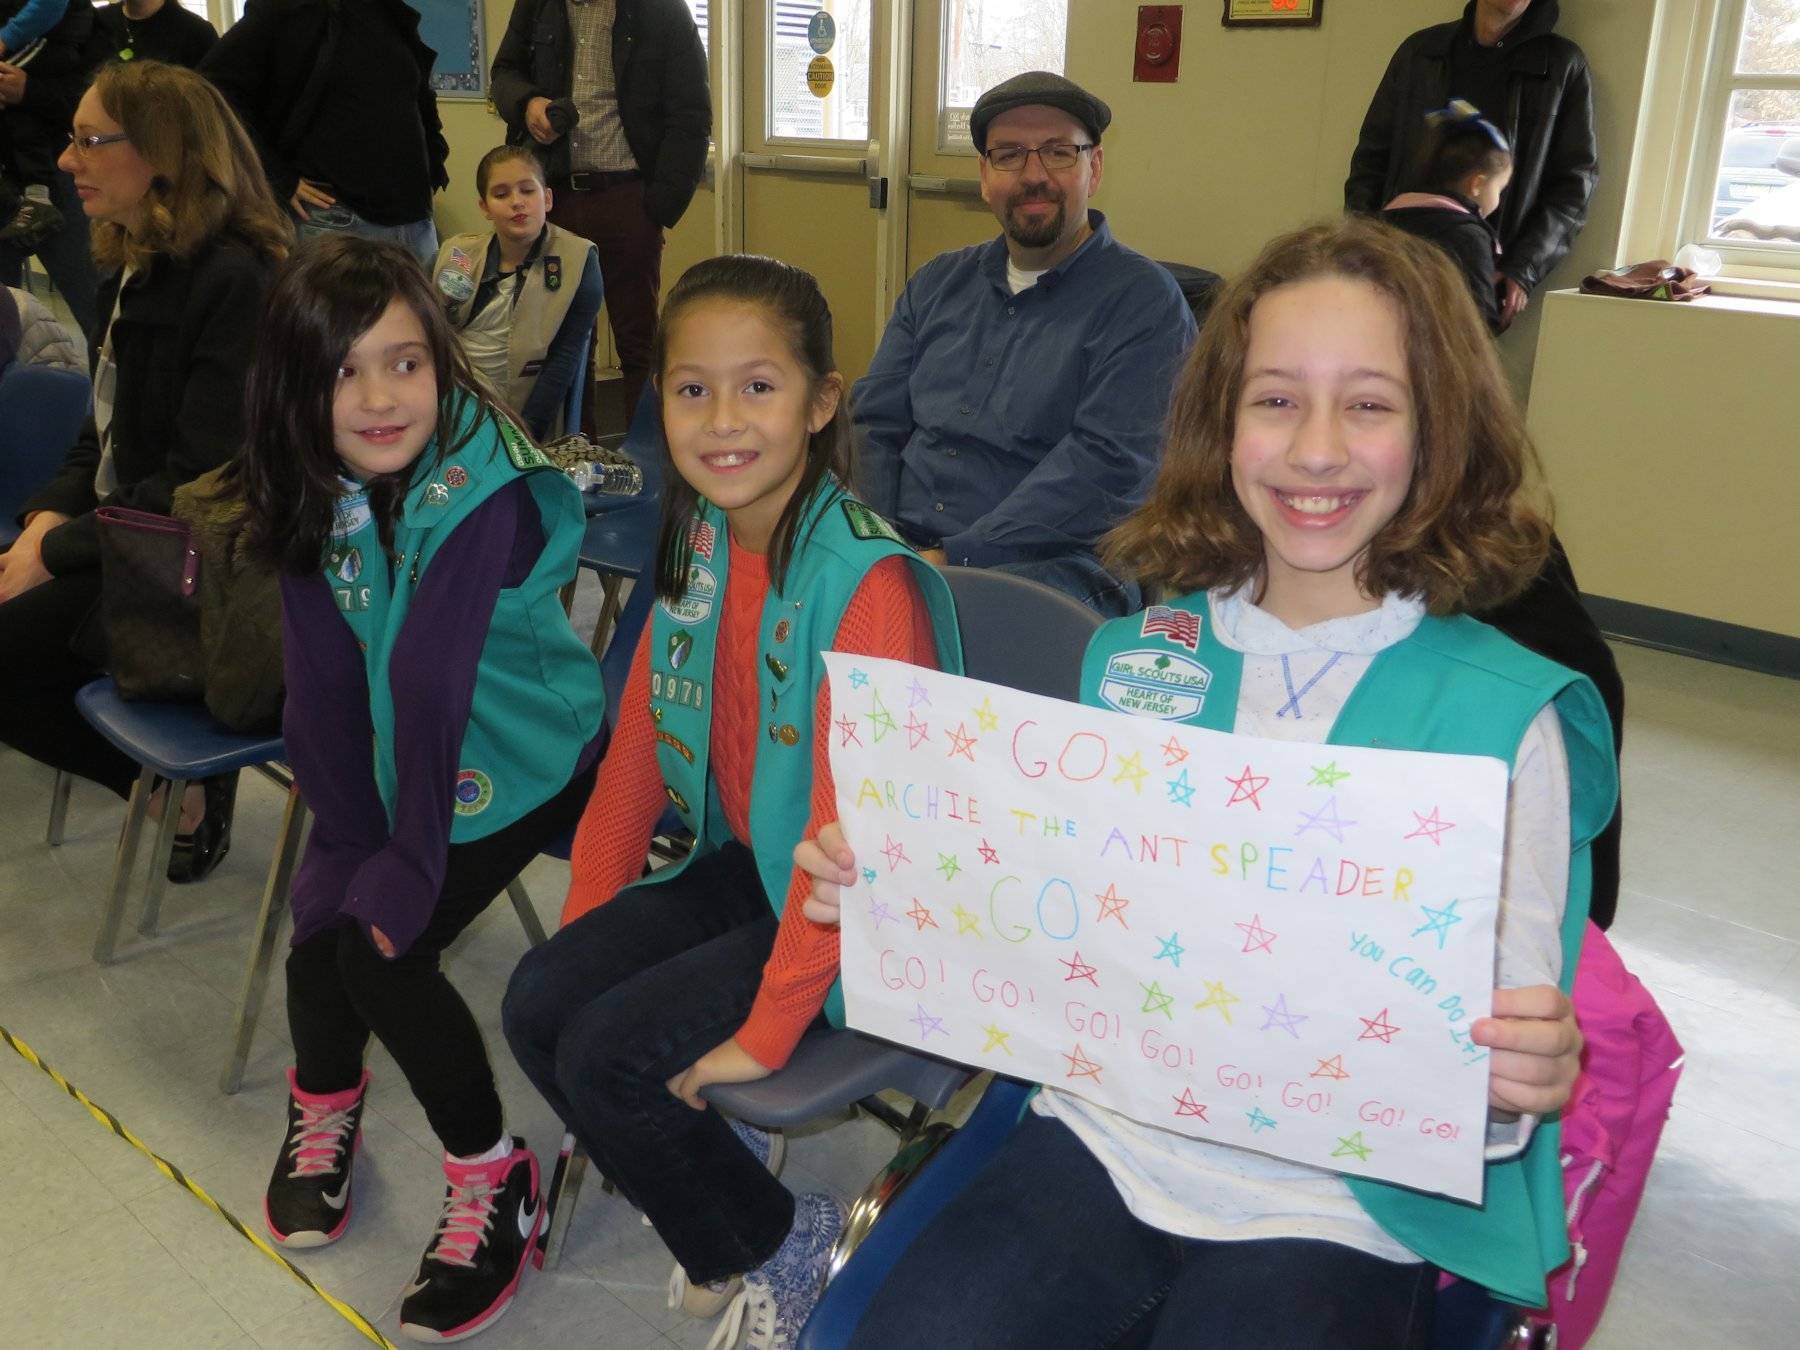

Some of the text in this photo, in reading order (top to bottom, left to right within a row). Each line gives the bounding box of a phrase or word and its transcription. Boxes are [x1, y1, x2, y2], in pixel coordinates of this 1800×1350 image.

[807, 72, 833, 81] CAUTION
[1111, 661, 1206, 687] GIRL SCOUTS USA
[1126, 687, 1174, 704] HEART OF
[1118, 697, 1177, 715] NEW JERSEY
[1012, 719, 1108, 781] GO
[856, 777, 1416, 901] ARCHIE THE ANT SPEADER
[989, 875, 1080, 943] GO
[880, 949, 946, 995] GO!
[971, 968, 1037, 1015] GO!
[1065, 1001, 1121, 1046] GO!
[1140, 1029, 1194, 1076] GO!
[1216, 1064, 1263, 1098] GO!
[1281, 1081, 1332, 1115] GO!
[1358, 1100, 1406, 1128] GO!
